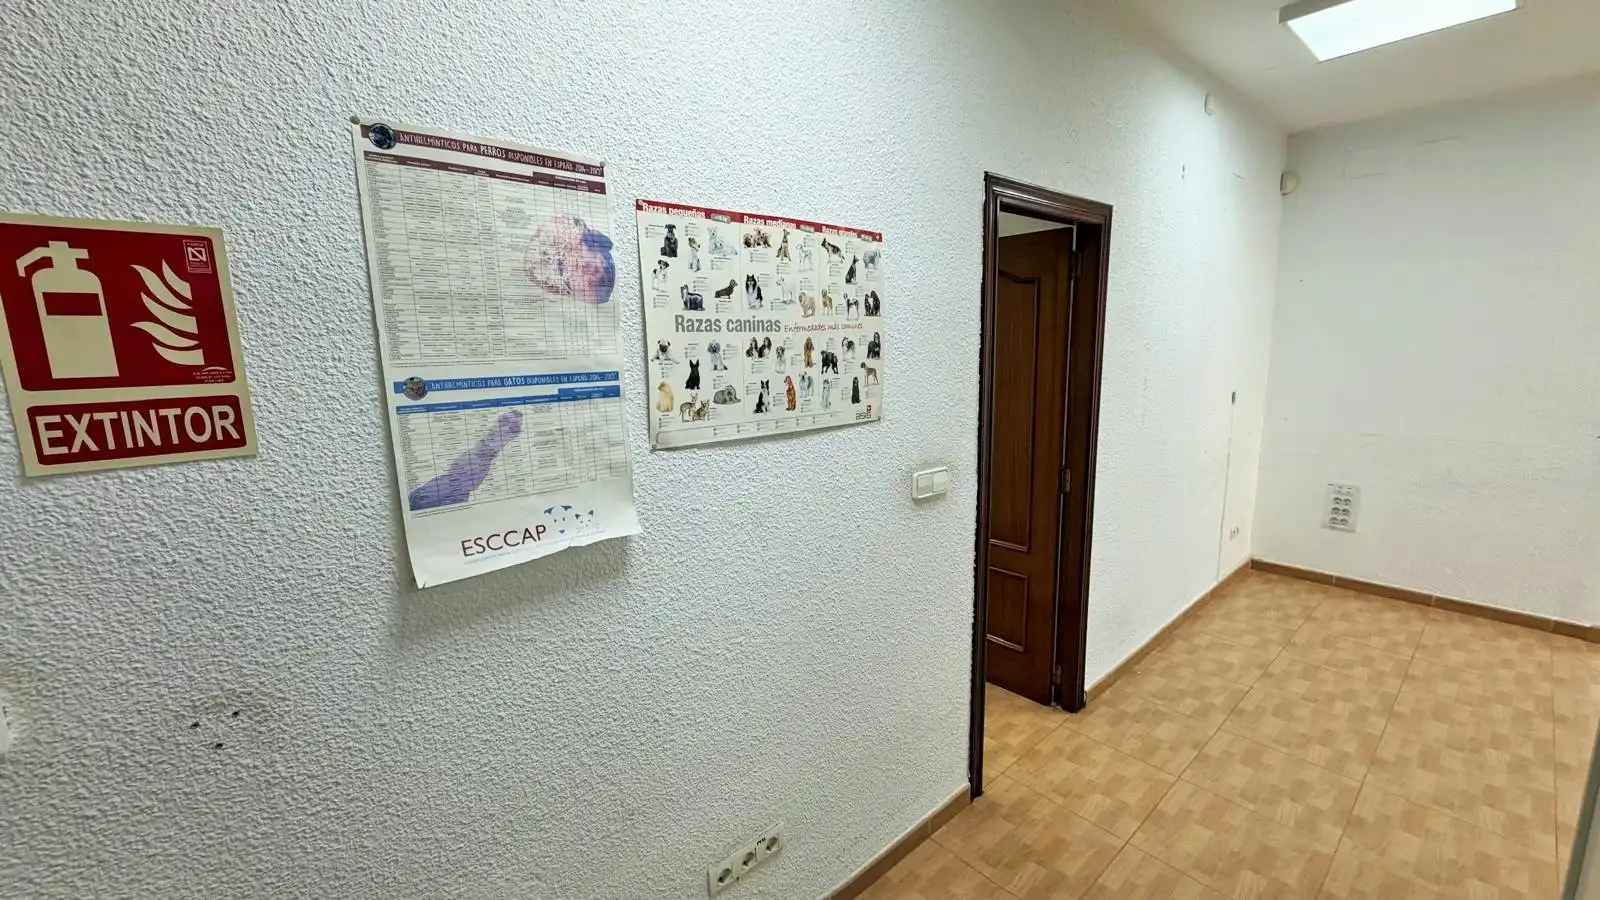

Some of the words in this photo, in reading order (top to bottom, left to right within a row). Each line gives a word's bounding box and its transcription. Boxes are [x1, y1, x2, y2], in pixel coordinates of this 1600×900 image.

[462, 142, 479, 153] PARA
[480, 145, 506, 158] PERROS
[508, 151, 544, 166] DISPONIBLES
[544, 159, 553, 168] EN
[642, 202, 667, 214] Razas
[668, 206, 706, 220] pequeñas
[743, 215, 765, 226] Razas
[674, 314, 722, 333] Razas
[726, 315, 781, 333] caninas
[784, 322, 827, 334] Enfermedades
[827, 321, 840, 331] más
[487, 378, 502, 388] PARA
[503, 377, 525, 387] GATOS
[35, 405, 241, 455] EXTINTOR
[460, 524, 547, 556] ESCCAP
